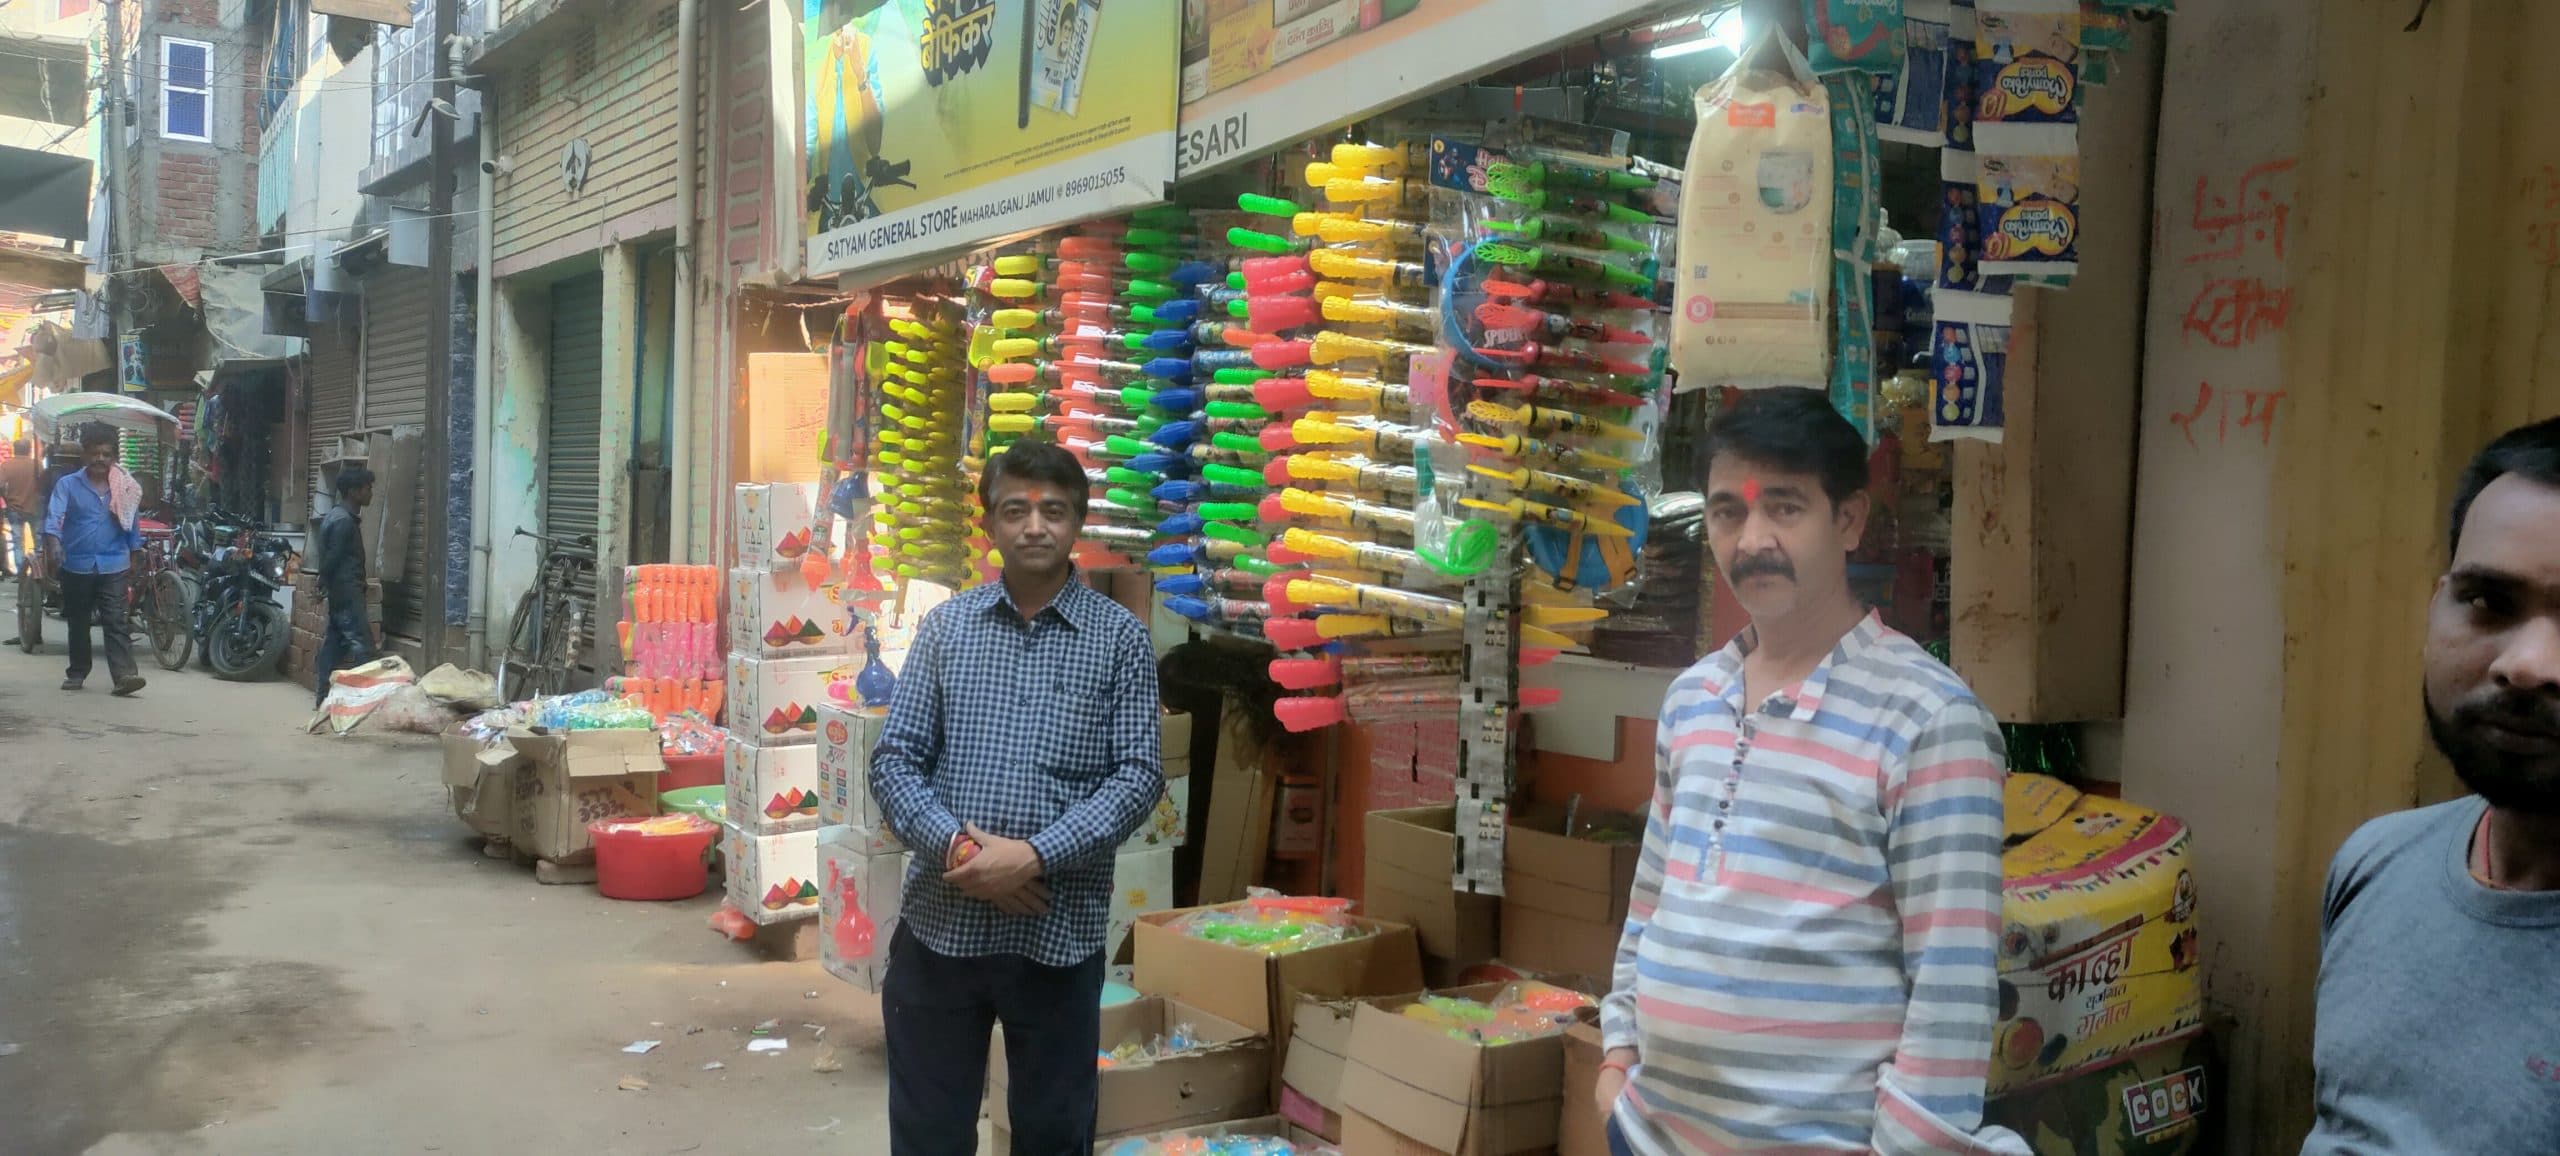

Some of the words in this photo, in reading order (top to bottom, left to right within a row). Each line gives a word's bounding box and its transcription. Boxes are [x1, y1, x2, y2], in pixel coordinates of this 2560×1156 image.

[920, 4, 995, 72] बेफिकर
[2001, 75, 2067, 99] MamyPoko
[827, 233, 867, 261] SATYAM
[868, 216, 918, 251] GENERAL
[919, 205, 958, 238] STORE
[959, 197, 1025, 226] MAHARAJGANJ
[1024, 186, 1055, 210] JAMUI
[1064, 166, 1125, 199] 8969015055
[2003, 217, 2070, 241] MamyPoko
[2132, 1076, 2202, 1124] COCK
